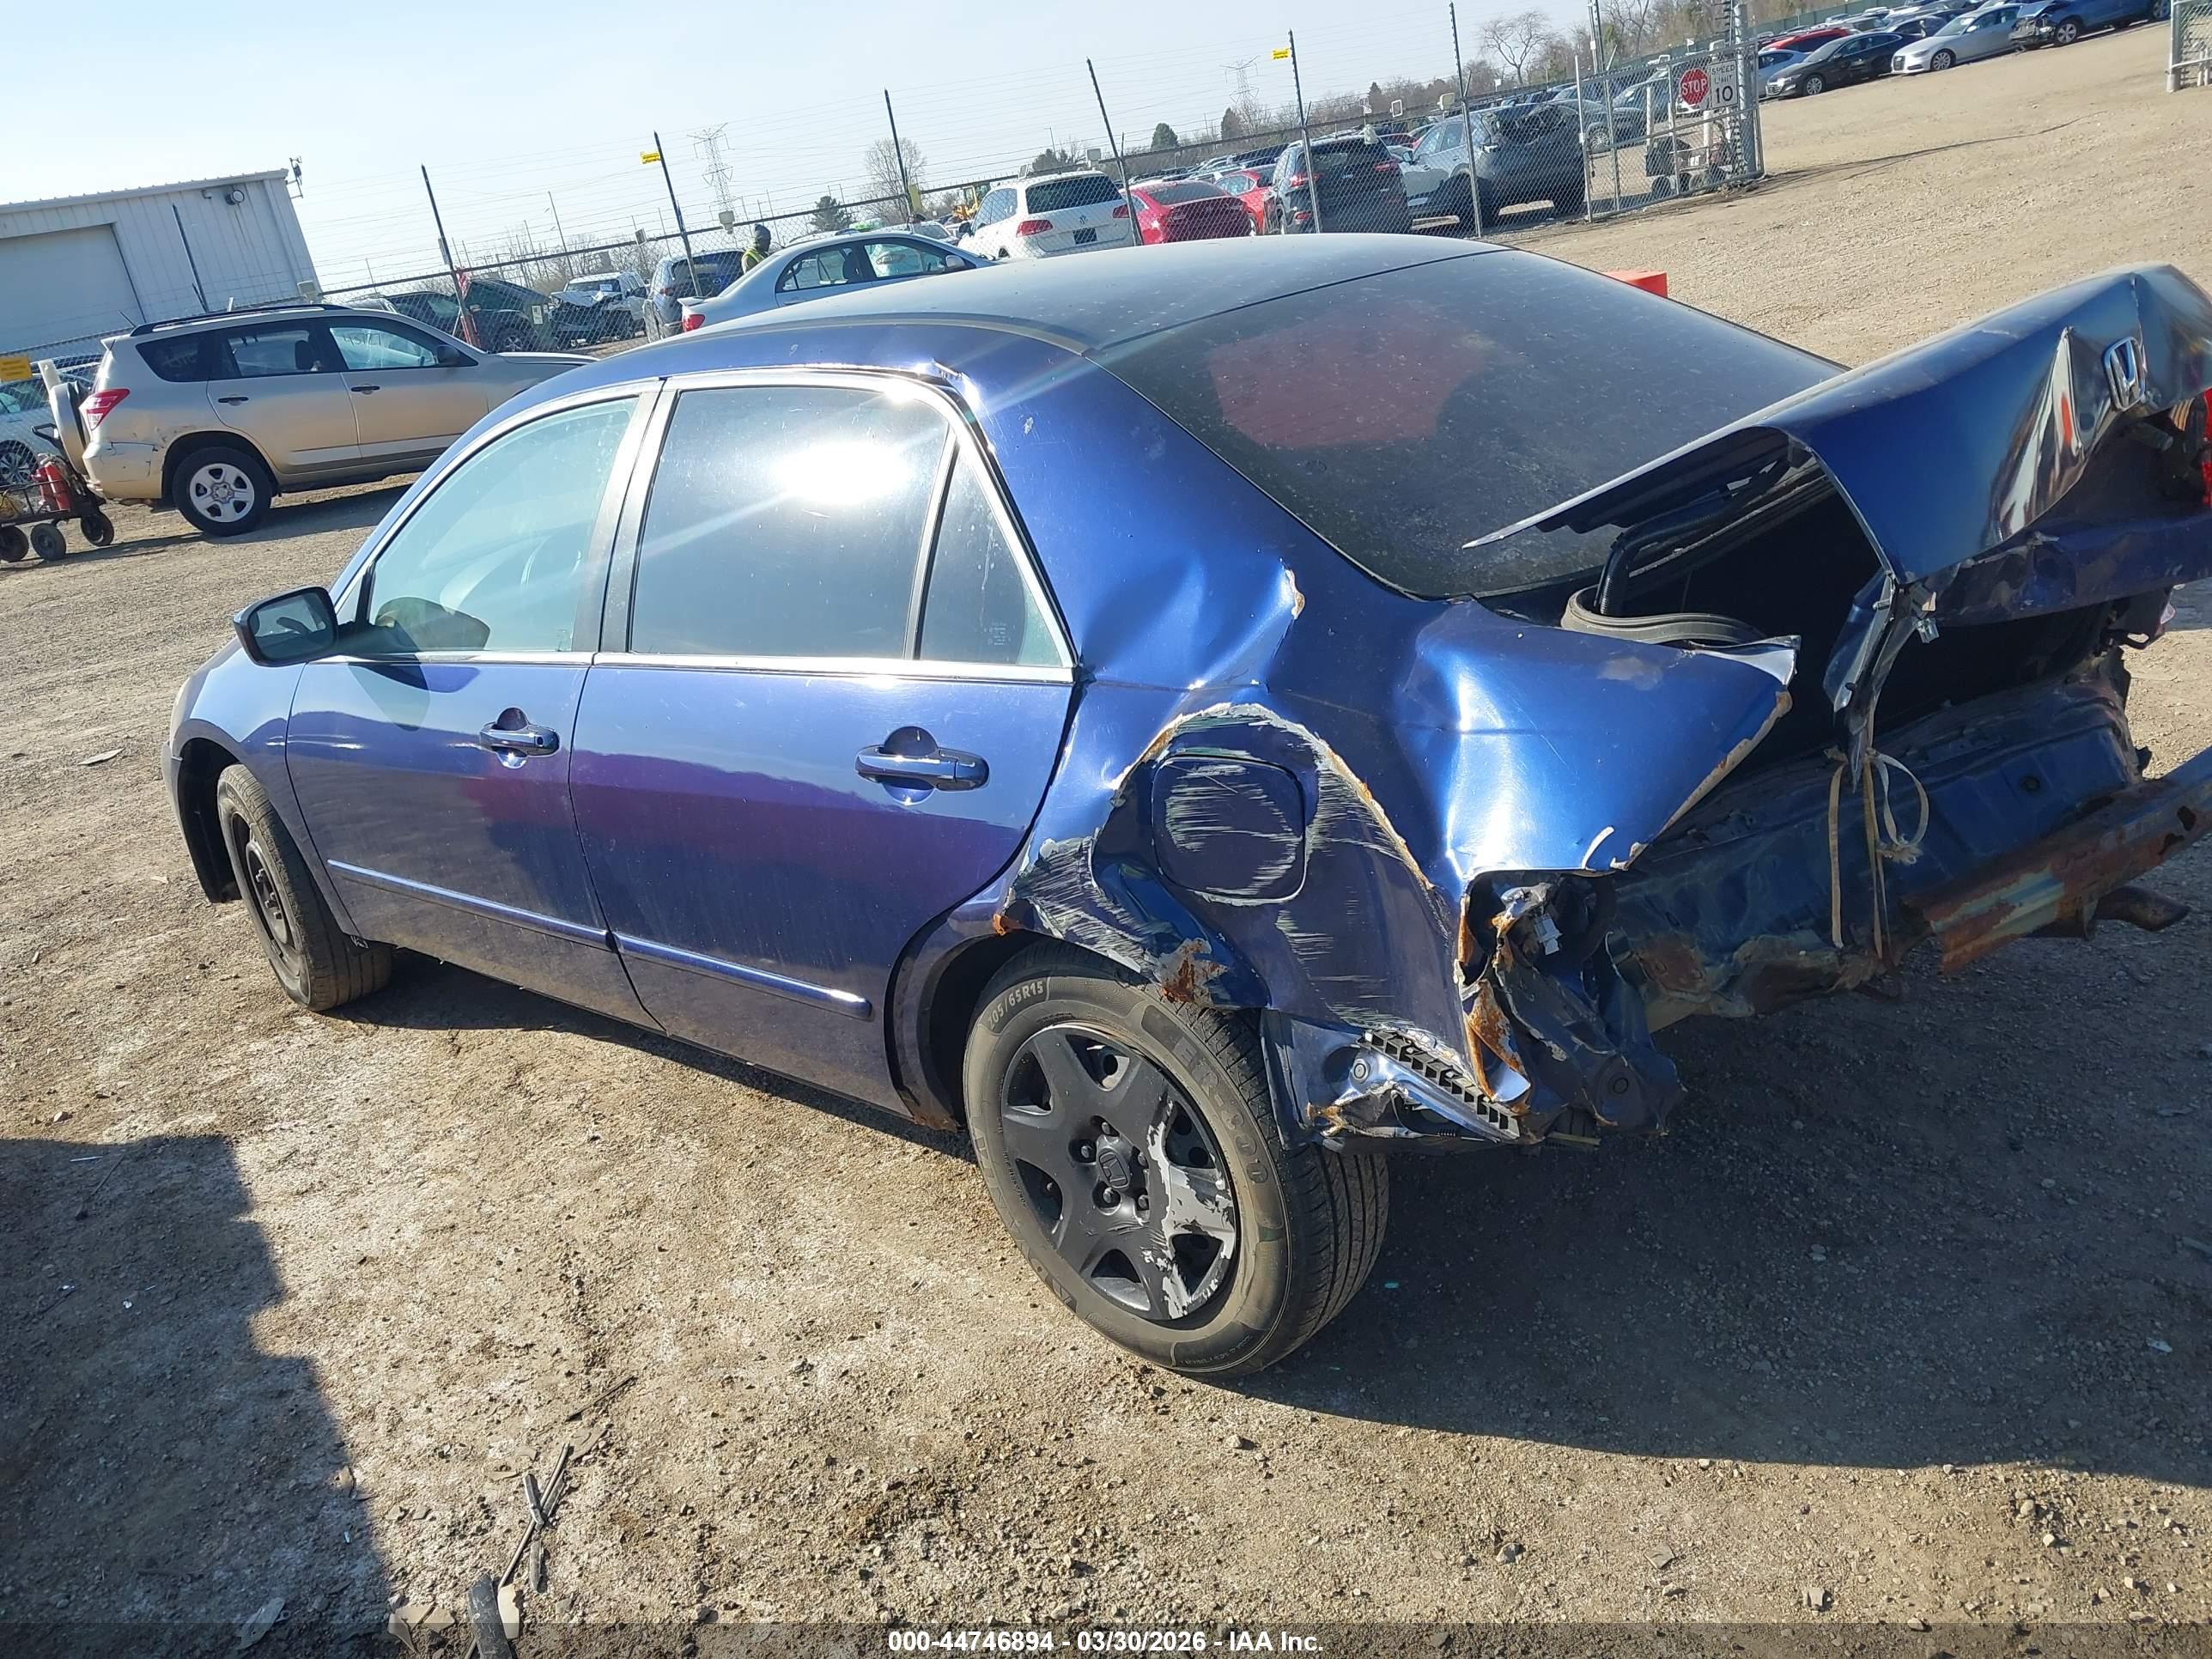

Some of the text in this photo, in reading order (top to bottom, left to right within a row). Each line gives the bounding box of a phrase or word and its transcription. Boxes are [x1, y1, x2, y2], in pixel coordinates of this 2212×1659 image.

[1711, 64, 1735, 76] SPEED
[1681, 78, 1707, 95] STOP
[1716, 85, 1734, 103] 10
[988, 981, 1044, 1030] 205/65R15
